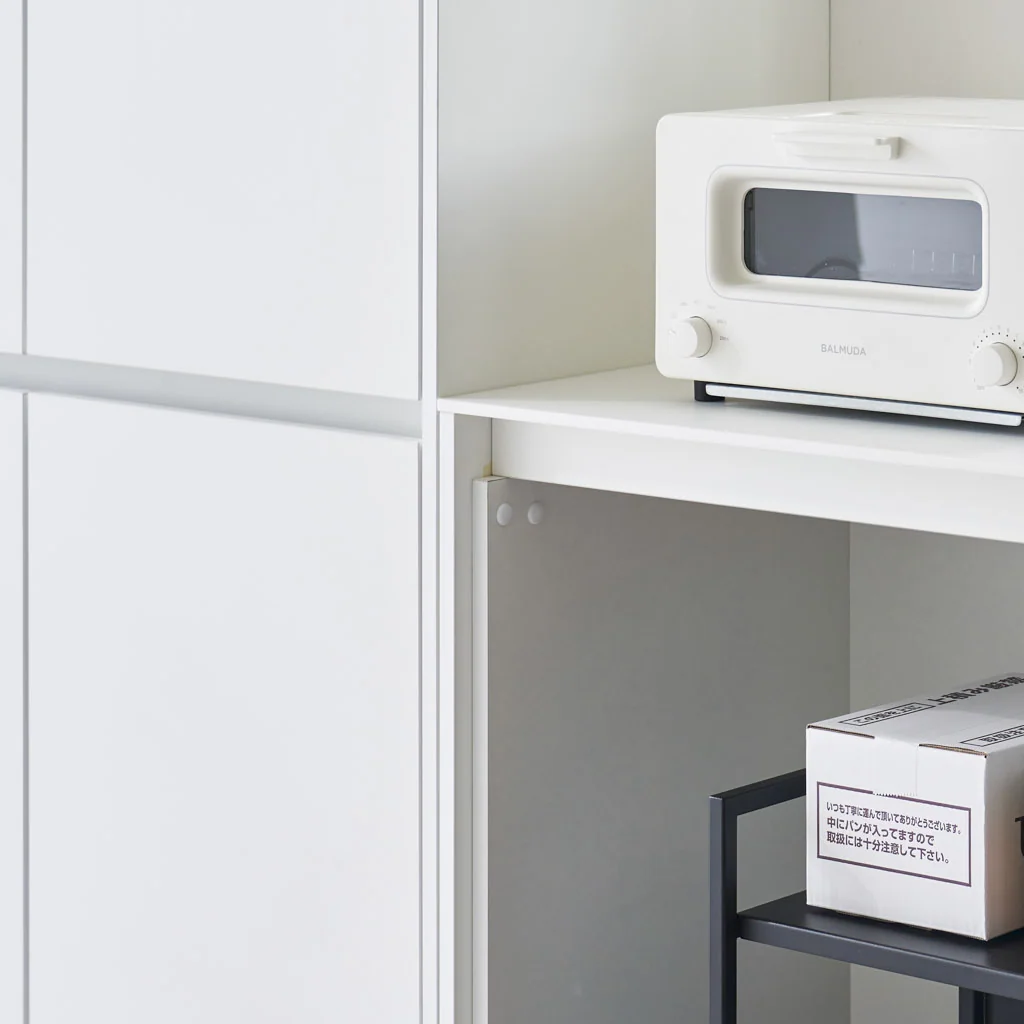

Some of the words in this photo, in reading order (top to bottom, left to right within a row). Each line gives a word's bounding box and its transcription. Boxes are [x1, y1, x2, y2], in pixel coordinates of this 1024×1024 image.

[821, 343, 867, 356] BALMUDA
[826, 816, 935, 847] 中にパンが入ってますので
[826, 831, 950, 864] 取扱には十分注意して下さい。
